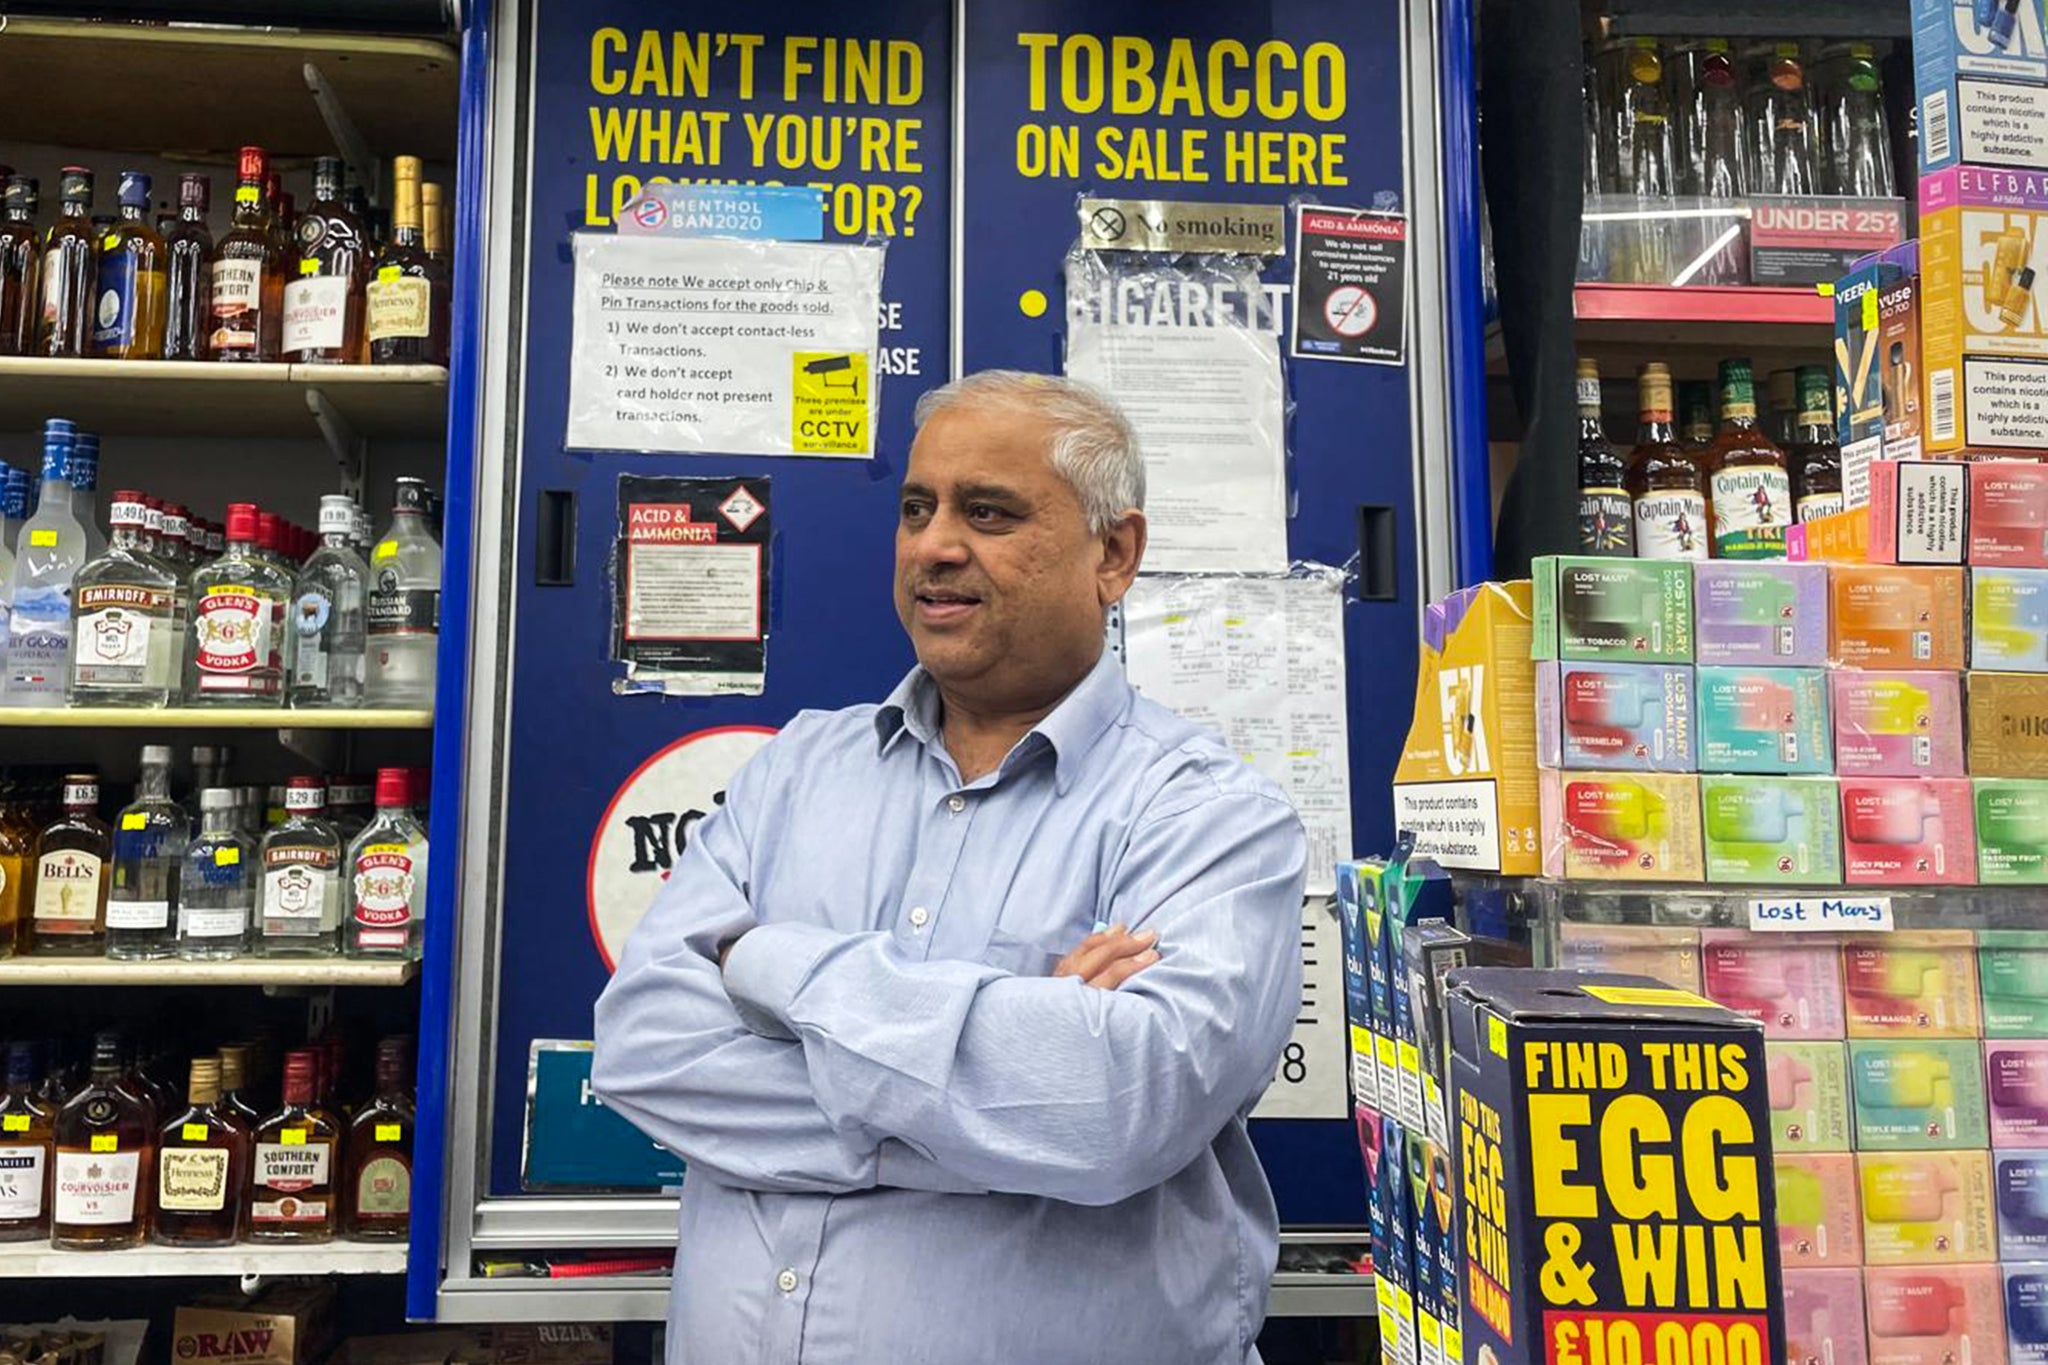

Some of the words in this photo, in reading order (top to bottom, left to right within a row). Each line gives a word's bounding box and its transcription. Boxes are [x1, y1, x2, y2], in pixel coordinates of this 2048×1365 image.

[590, 27, 765, 99] CAN'T
[784, 36, 924, 105] FIND
[1018, 32, 1347, 122] TOBACCO
[1976, 90, 1996, 101] This
[1998, 93, 2034, 105] product
[1966, 104, 2006, 116] contains
[2009, 107, 2046, 118] nicotine
[1983, 119, 2010, 129] which
[2012, 120, 2020, 129] is
[589, 106, 730, 165] WHAT
[744, 113, 923, 172] YOU'RE
[1971, 131, 2000, 143] highly
[2003, 133, 2044, 145] addictive
[1017, 124, 1079, 178] ON
[1096, 126, 1208, 182] SALE
[1225, 131, 1348, 186] HERE
[1983, 145, 2033, 157] substance.
[672, 199, 763, 214] MENTHOL
[672, 215, 762, 231] BAN2020
[1310, 219, 1335, 229] ACID
[1757, 208, 1849, 231] UNDER
[1856, 212, 1898, 233] 25?
[1177, 215, 1274, 242] smoking
[1352, 242, 1366, 250] not
[1363, 264, 1386, 273] under
[602, 273, 644, 287] Please
[648, 276, 679, 287] note
[682, 275, 704, 287] We
[708, 278, 750, 291] accept
[754, 279, 782, 292] only
[602, 296, 622, 308] Pin
[626, 297, 708, 310] Transactions
[713, 298, 731, 310] for
[736, 299, 756, 311] the
[760, 301, 800, 313] goods
[803, 302, 833, 313] sold.
[607, 322, 620, 335] 1)
[627, 322, 648, 334] We
[652, 323, 688, 335] don't
[691, 324, 733, 337] accept
[737, 326, 815, 337] contact-less
[619, 344, 707, 357] Transactions.
[605, 365, 617, 378] 2)
[624, 366, 647, 378] We
[651, 366, 686, 379] don't
[690, 368, 733, 381] accept
[1984, 371, 2005, 381] This
[2009, 373, 2046, 384] product
[617, 387, 646, 399] card
[650, 388, 693, 400] holder
[697, 391, 719, 401] not
[723, 391, 773, 403] present
[1973, 386, 2016, 396] contains
[1990, 400, 2020, 410] which
[2022, 401, 2031, 410] is
[1977, 412, 2009, 424] highly
[800, 420, 860, 437] CCTV
[1990, 427, 2045, 439] substance.
[1717, 471, 1760, 494] Captain
[1984, 482, 2009, 490] LOST
[1638, 498, 1680, 519] Captain
[632, 510, 670, 523] ACID
[674, 510, 687, 523] &
[632, 527, 713, 542] AMMONIA
[1574, 573, 1599, 582] LOST
[1602, 574, 1629, 582] MARY
[1710, 581, 1734, 589] LOST
[1737, 581, 1763, 589] MARY
[86, 588, 146, 603] SMIRNOFF
[1674, 570, 1686, 609] LOST
[1676, 612, 1688, 654] MARY
[1587, 638, 1627, 646] TOBACCO
[206, 653, 249, 667] VODKA
[1577, 680, 1601, 689] LOST
[1675, 673, 1687, 711] LOST
[1712, 685, 1737, 693] LOST
[1738, 685, 1764, 693] MARY
[1677, 716, 1688, 759] MARY
[1578, 791, 1603, 800] LOST
[1855, 797, 1881, 806] LOST
[1418, 797, 1444, 812] product
[1446, 797, 1478, 810] contains
[1426, 820, 1446, 832] which
[1455, 822, 1460, 832] a
[1462, 818, 1485, 836] highly
[272, 850, 321, 861] SMIRNOFF
[44, 863, 93, 879] BELL'S
[1874, 861, 1901, 869] PEACH
[364, 910, 403, 922] VODKA
[1758, 902, 1807, 921] Lost
[1822, 900, 1882, 921] Mary
[1347, 954, 1363, 976] blu
[1370, 960, 1385, 983] blu
[1394, 969, 1408, 993] blu
[1524, 1041, 1628, 1089] FIND
[1642, 1043, 1749, 1091] THIS
[1866, 1060, 1890, 1069] LOST
[2000, 1059, 2024, 1068] LOST
[1460, 1088, 1478, 1127] FIND
[1480, 1101, 1501, 1145] THIS
[264, 1152, 320, 1163] SOUTHERN
[1528, 1093, 1761, 1222] EGG
[267, 1165, 315, 1176] COMFORT
[1462, 1121, 1506, 1233] EGG
[2009, 1168, 2032, 1178] LOST
[61, 1182, 130, 1193] COURVOISIER
[1369, 1200, 1384, 1224] blu
[1392, 1214, 1405, 1241] blu
[1415, 1229, 1431, 1258] blu
[1466, 1203, 1477, 1260] &
[1478, 1214, 1510, 1292] WIN
[1439, 1248, 1456, 1275] blu
[1539, 1222, 1598, 1306] &
[1612, 1223, 1767, 1309] WIN
[538, 1325, 594, 1342] RIZLA
[197, 1328, 274, 1358] RAW
